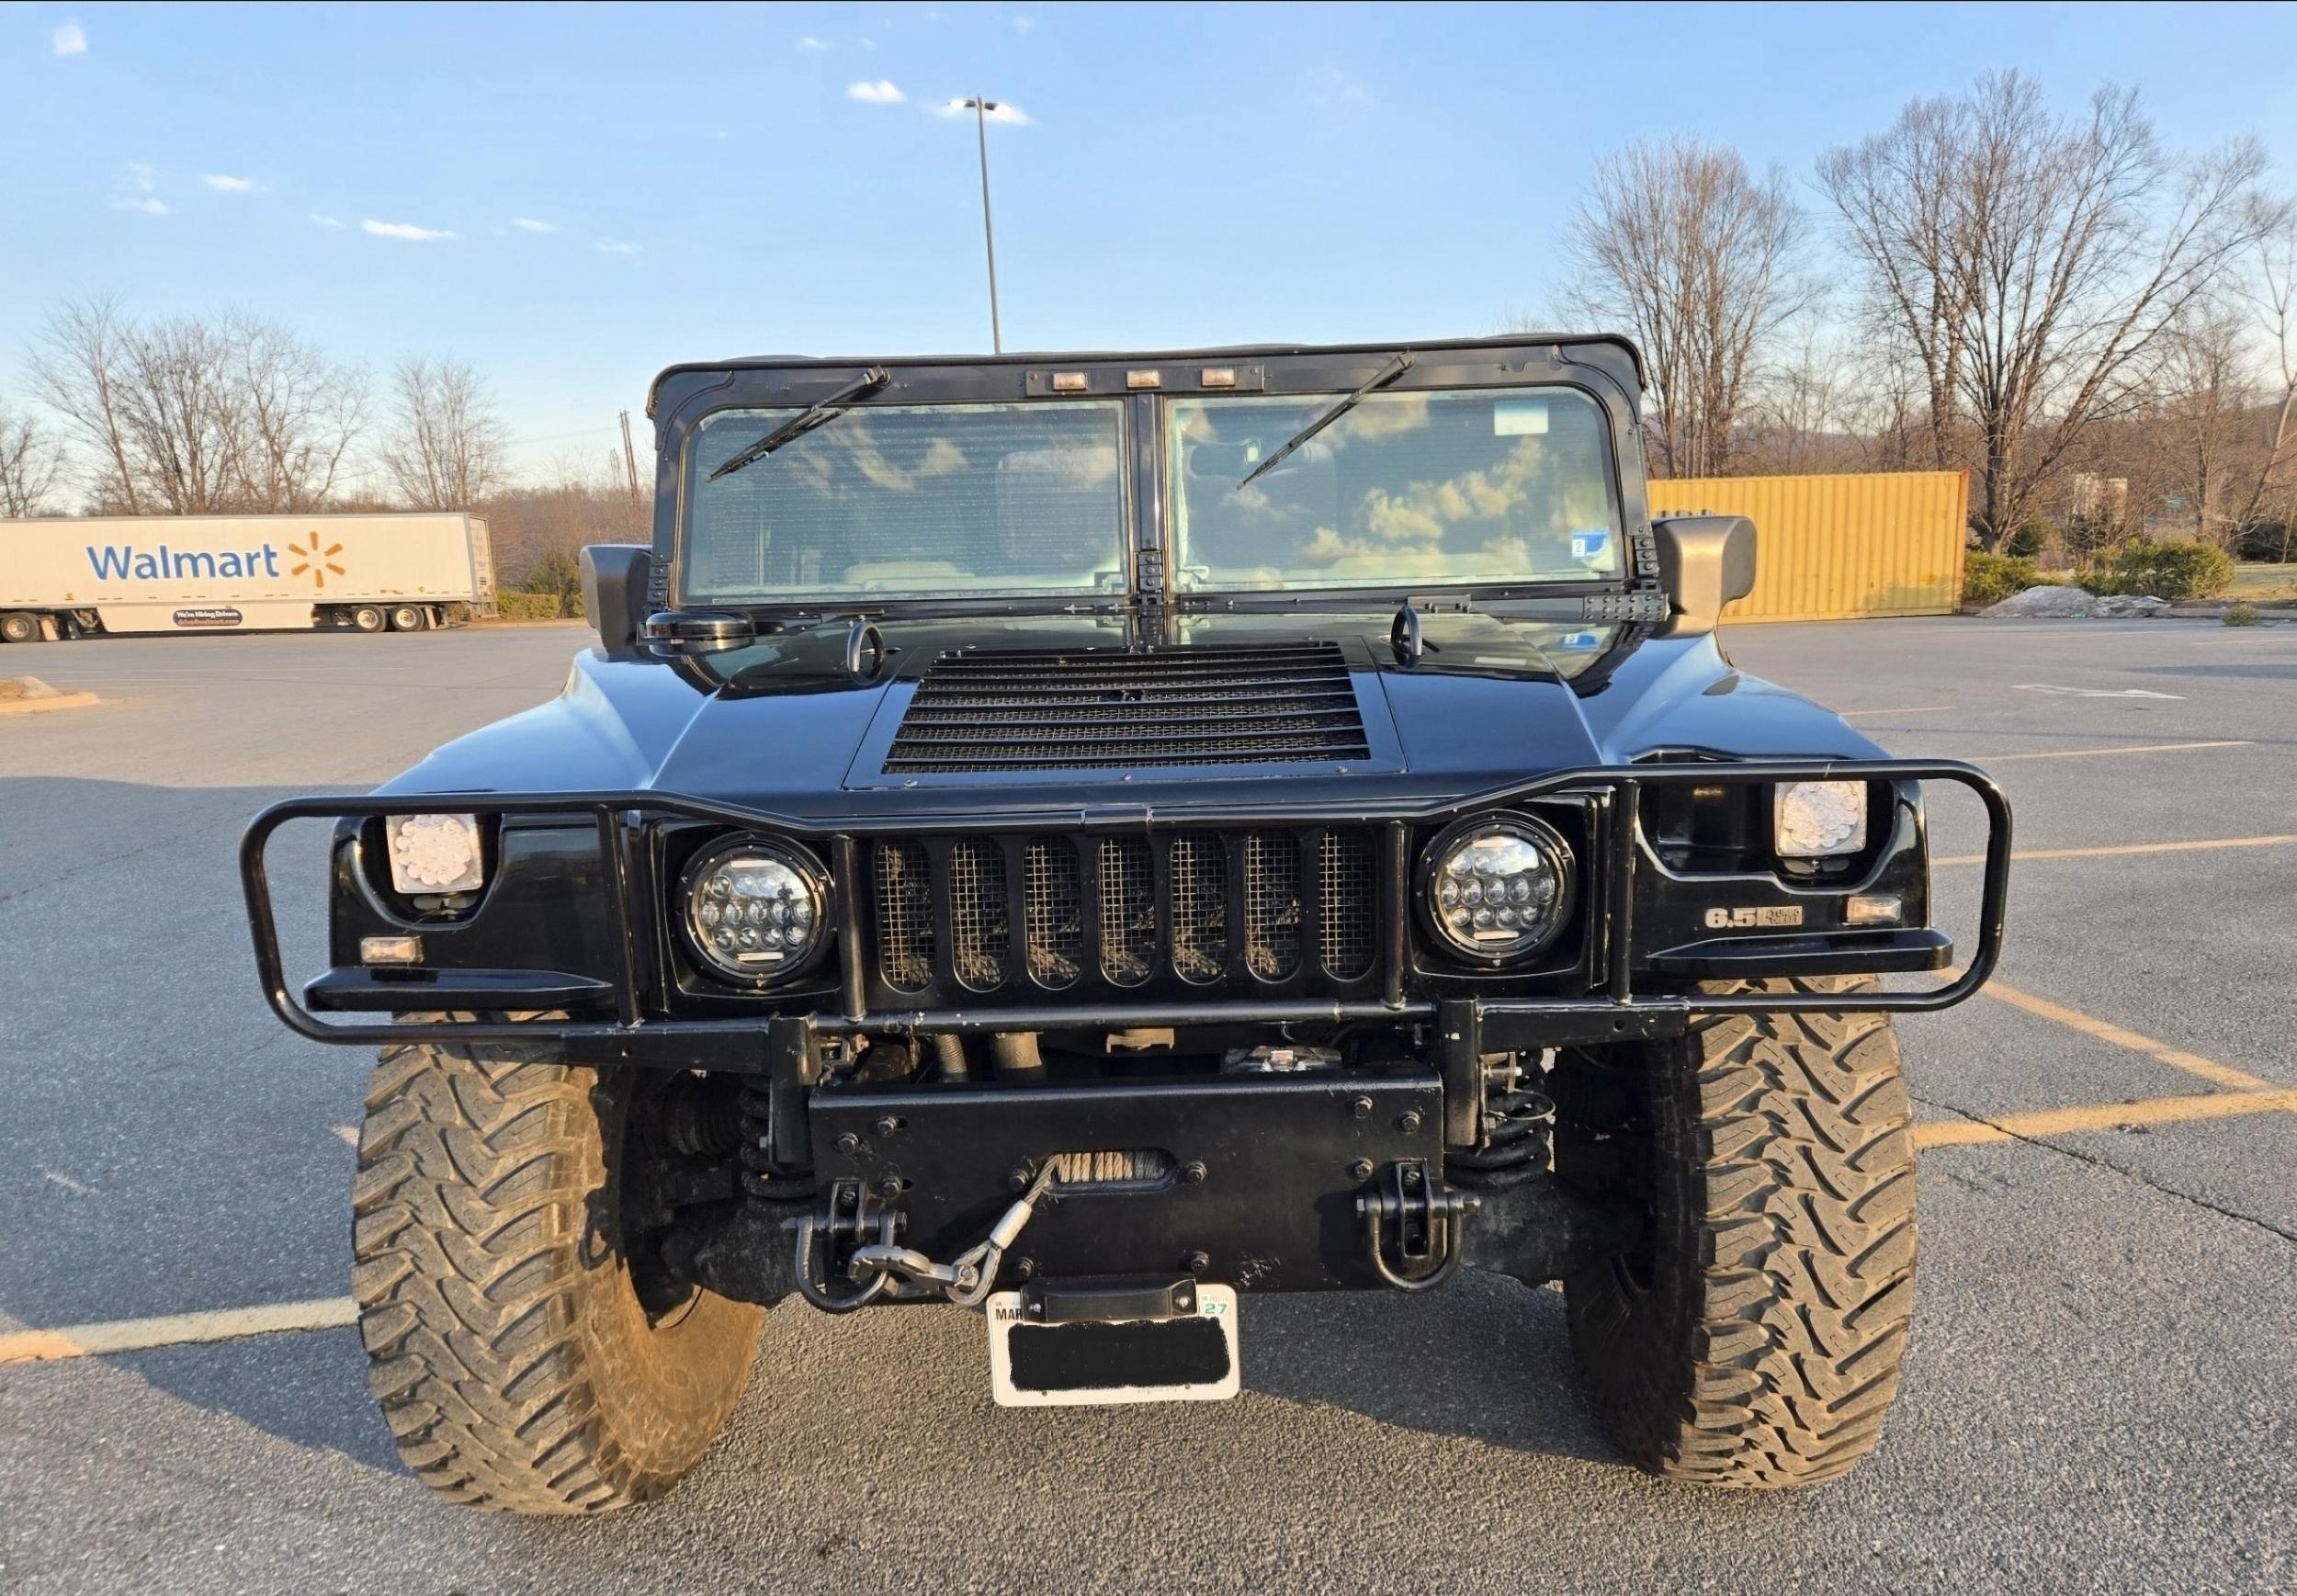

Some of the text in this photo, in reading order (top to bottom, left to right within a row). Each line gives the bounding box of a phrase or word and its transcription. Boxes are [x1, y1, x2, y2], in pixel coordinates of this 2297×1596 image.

[86, 544, 279, 580] Walmart
[1705, 907, 1756, 928] 6.5
[1205, 1303, 1228, 1314] 27
